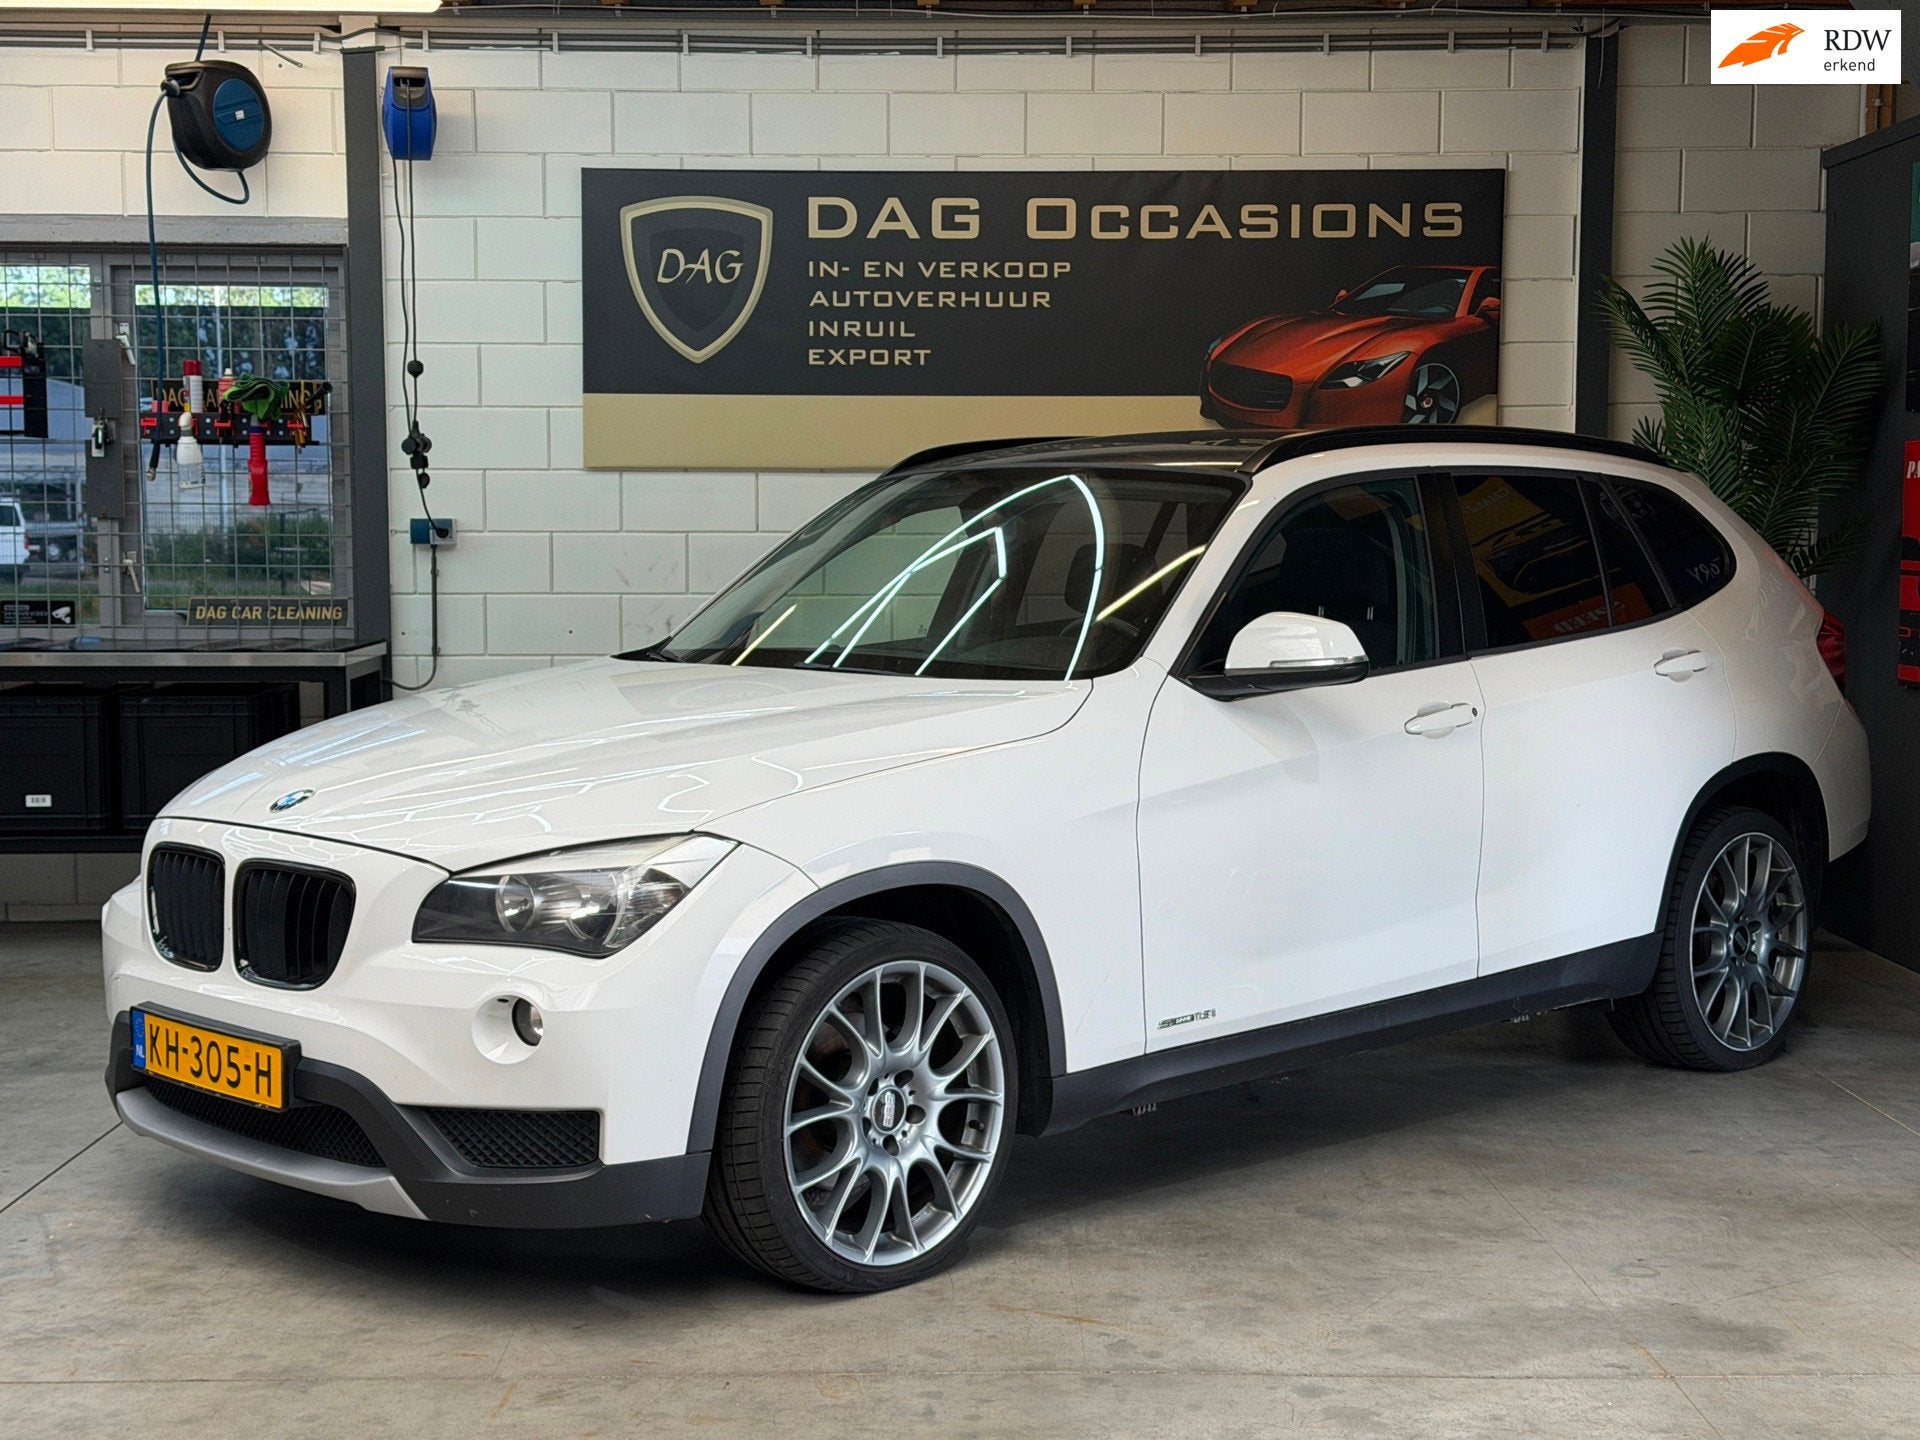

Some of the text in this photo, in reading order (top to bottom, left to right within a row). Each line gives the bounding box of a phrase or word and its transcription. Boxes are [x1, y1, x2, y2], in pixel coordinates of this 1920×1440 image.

[808, 196, 980, 240] DAG
[657, 247, 744, 284] DAG
[808, 260, 1071, 279] IN- EN VERKOOP
[809, 290, 1051, 308] AUTOVERHUUR
[808, 320, 916, 338] INRUIL
[808, 349, 932, 366] EXPORT
[195, 605, 343, 620] DAG CAR CLEANING
[149, 1022, 272, 1098] KH-305-H
